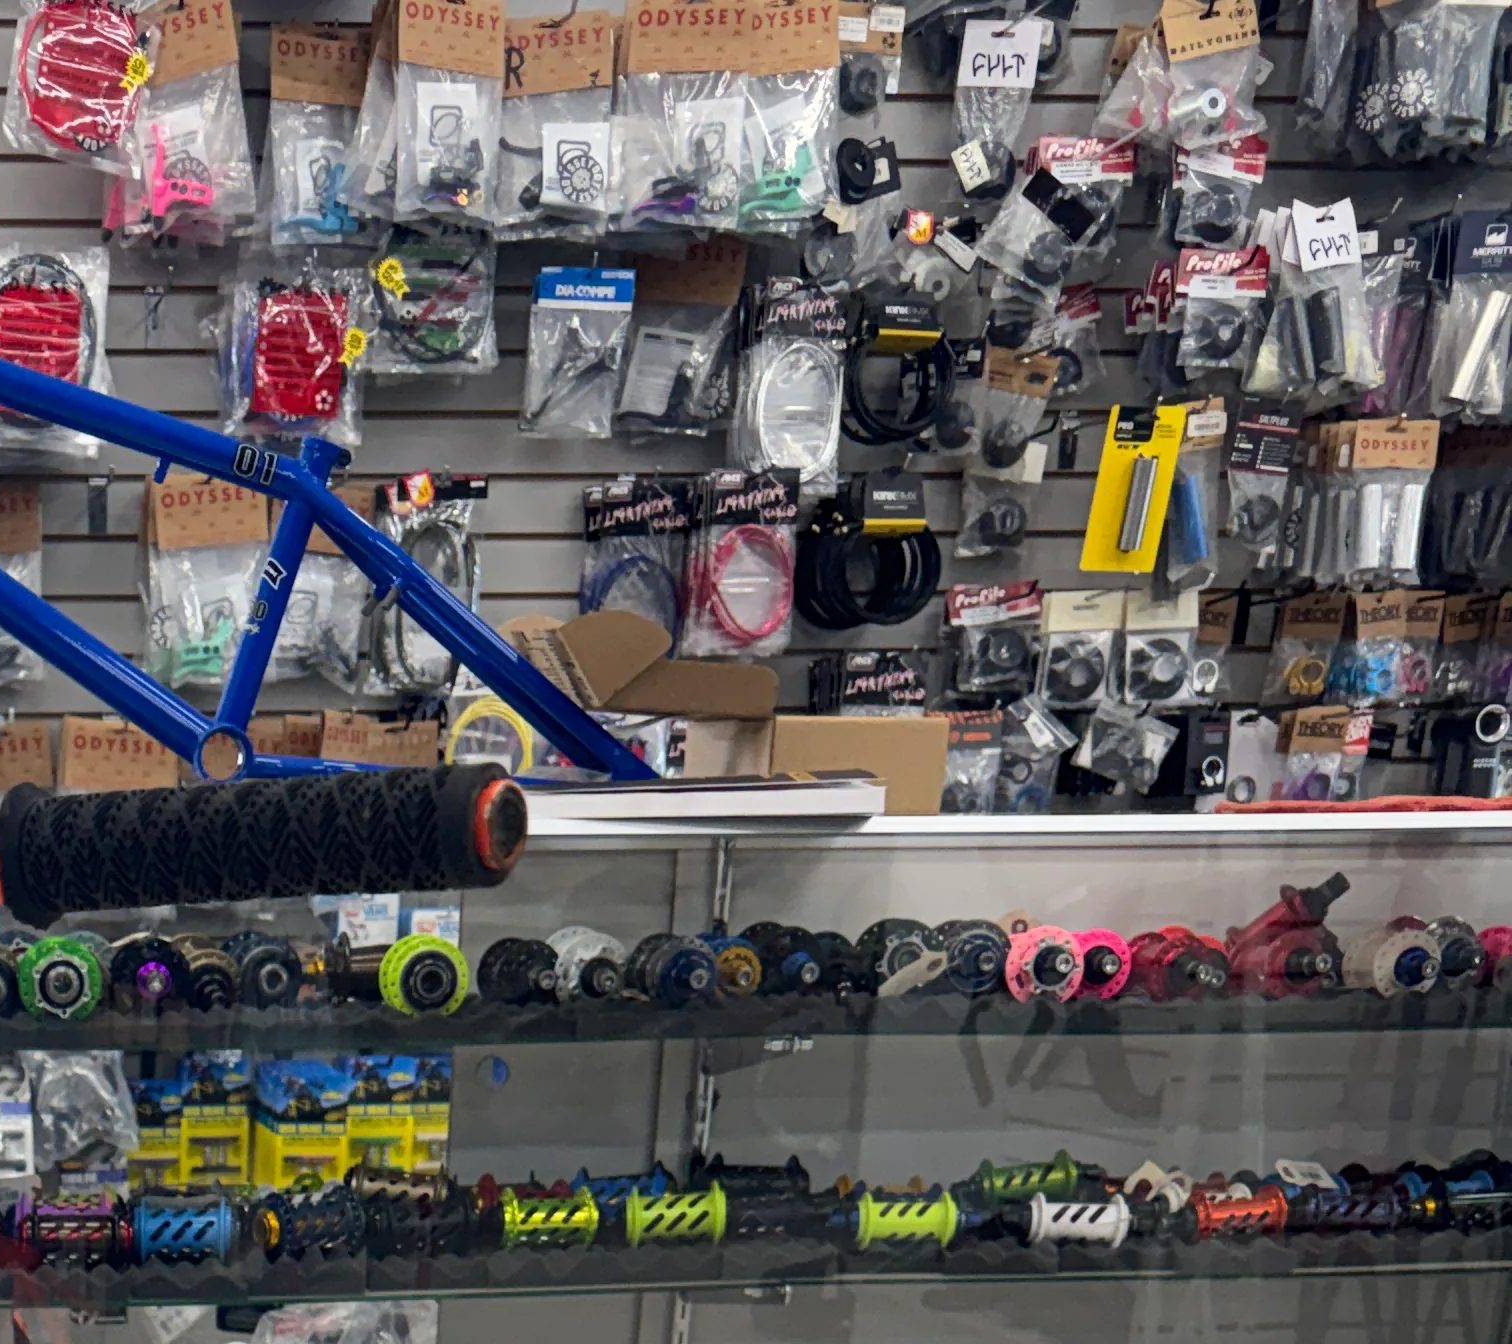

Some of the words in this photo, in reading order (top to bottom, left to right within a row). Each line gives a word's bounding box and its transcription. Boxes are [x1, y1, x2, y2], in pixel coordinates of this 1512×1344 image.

[158, 2, 226, 37] YSSEY
[405, 2, 500, 32] ODYSSEY
[639, 8, 745, 27] ODYSSEY
[752, 5, 832, 31] DYSSEY
[277, 39, 371, 64] ODYSSE
[1046, 138, 1108, 160] Profile
[1185, 251, 1242, 273] Profile
[1360, 438, 1429, 451] ODYSSEY
[1360, 603, 1403, 625] THEORY
[1406, 606, 1440, 623] EORY
